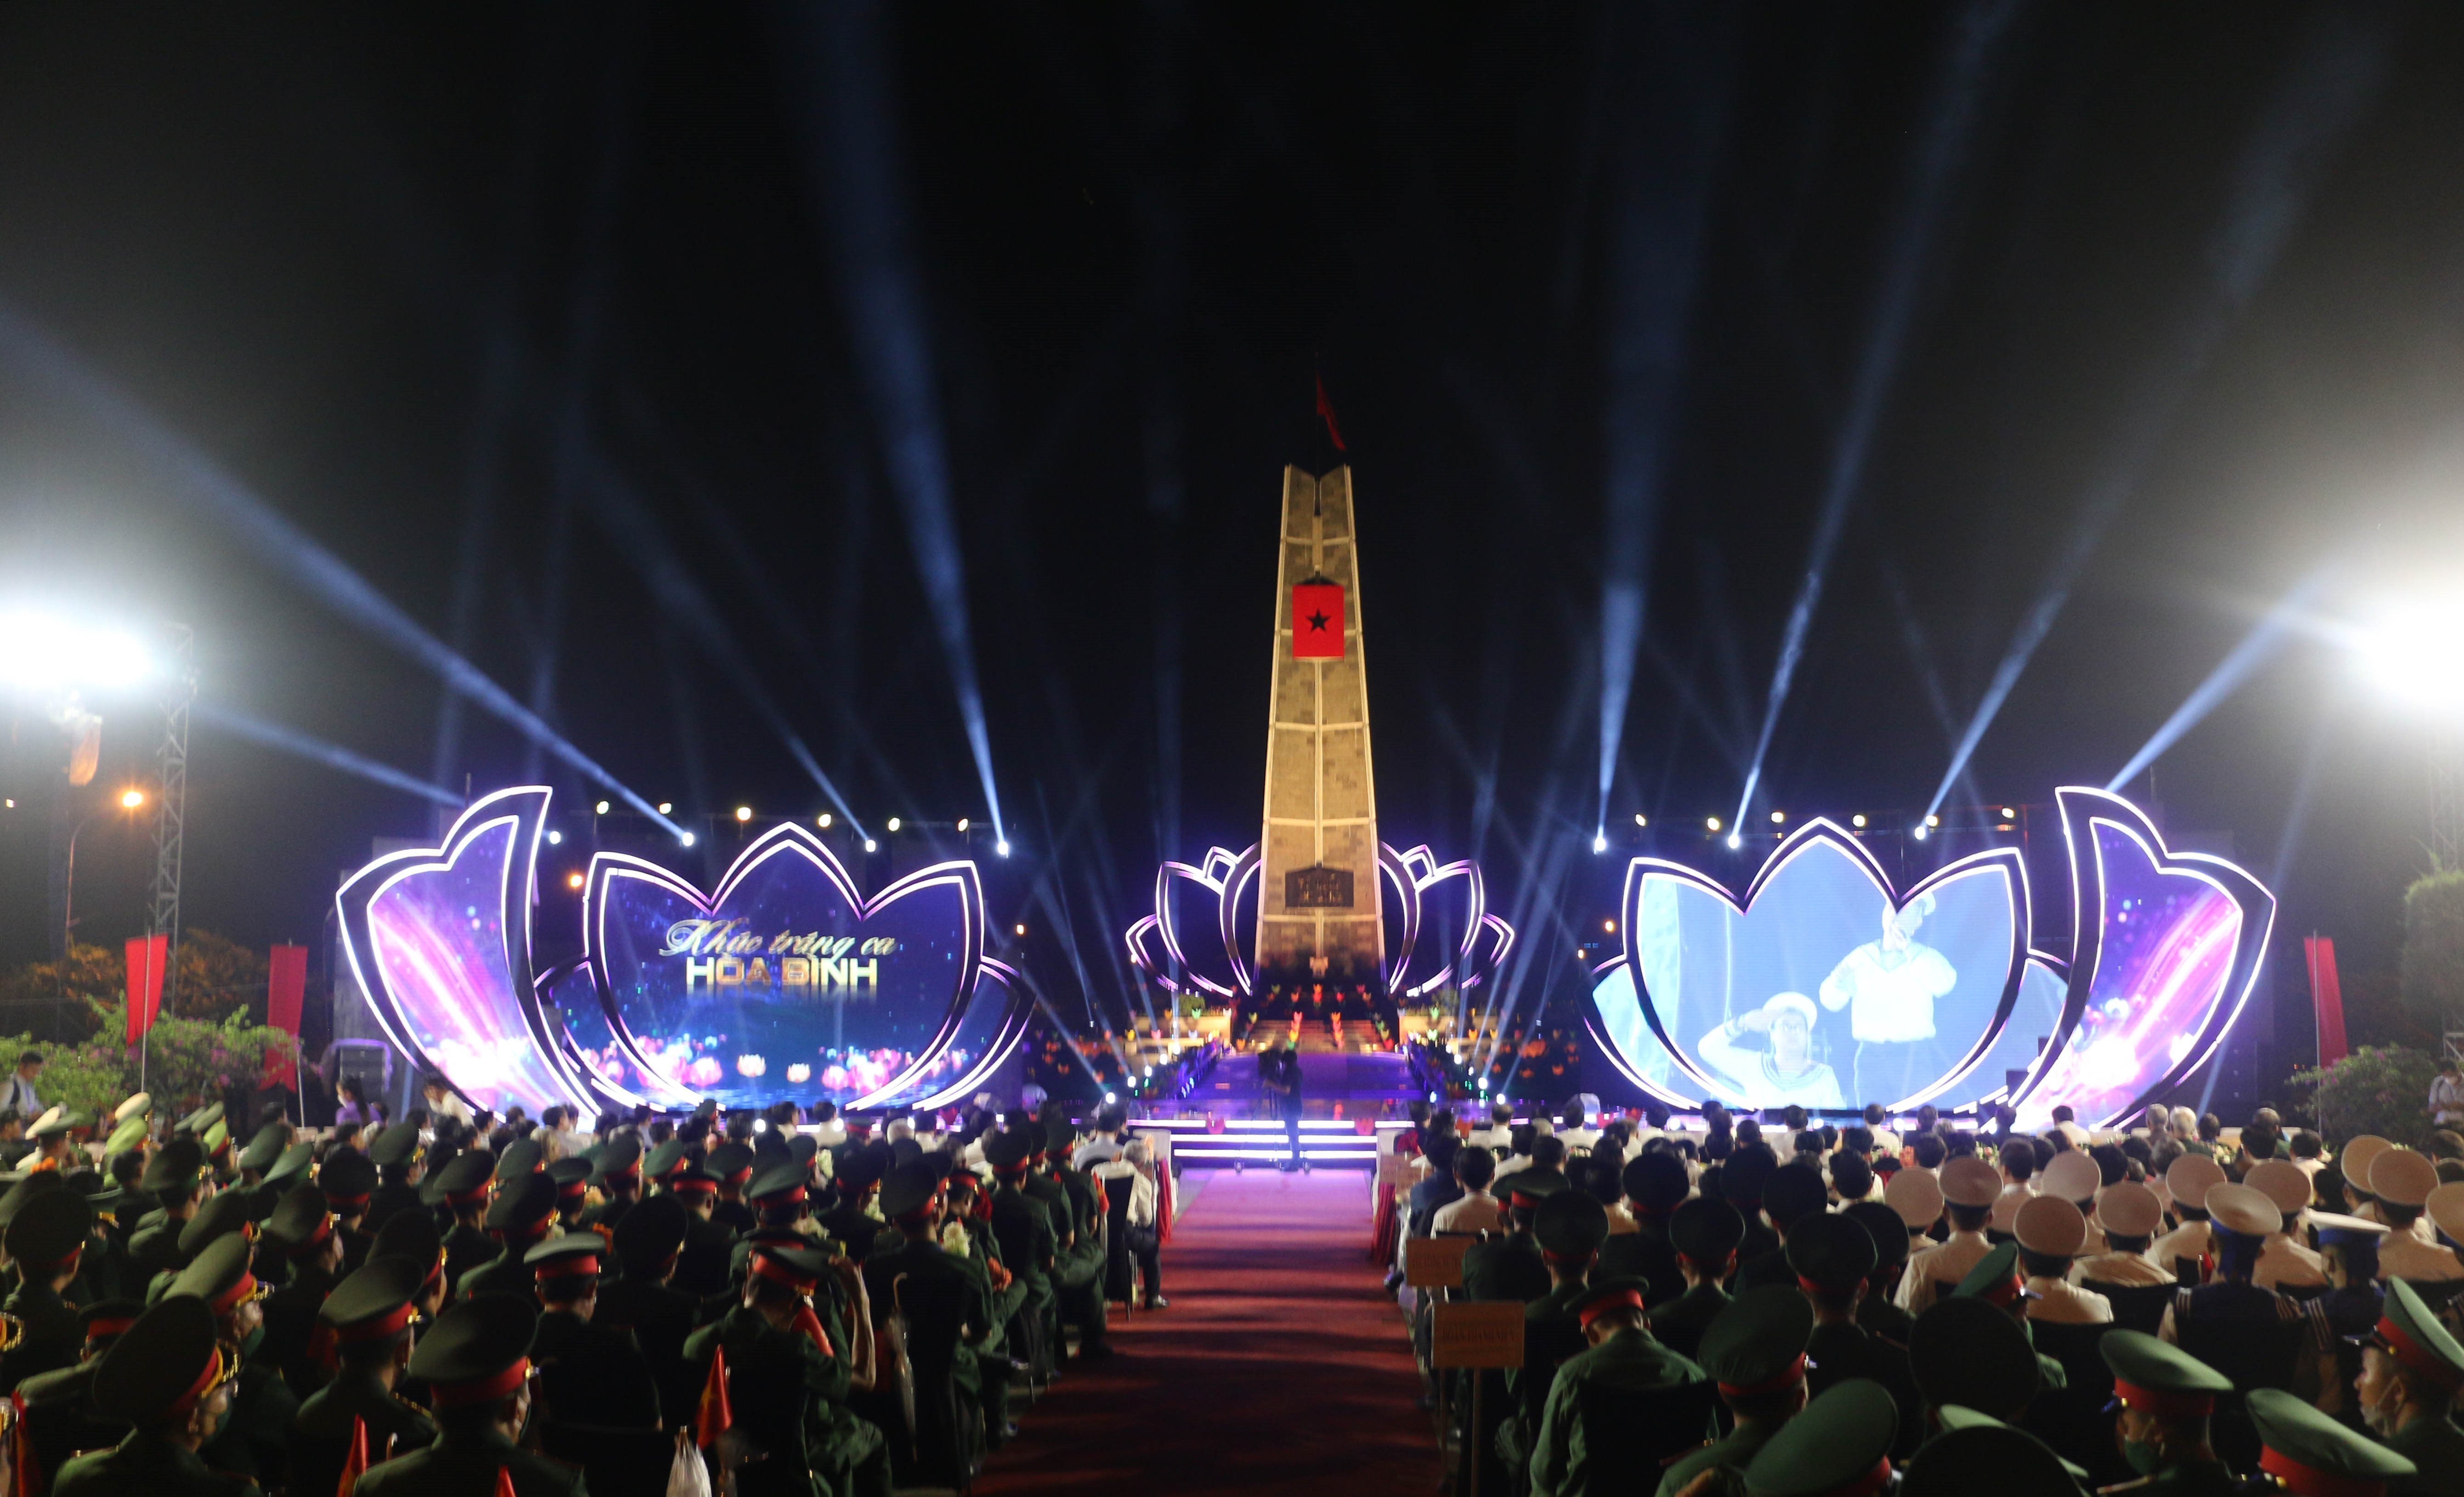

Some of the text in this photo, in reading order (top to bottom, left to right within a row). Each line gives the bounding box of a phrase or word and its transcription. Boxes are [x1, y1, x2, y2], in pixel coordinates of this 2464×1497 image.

[659, 917, 897, 963] Khúc tráng ca
[686, 952, 878, 986] HÒA BÌNH
